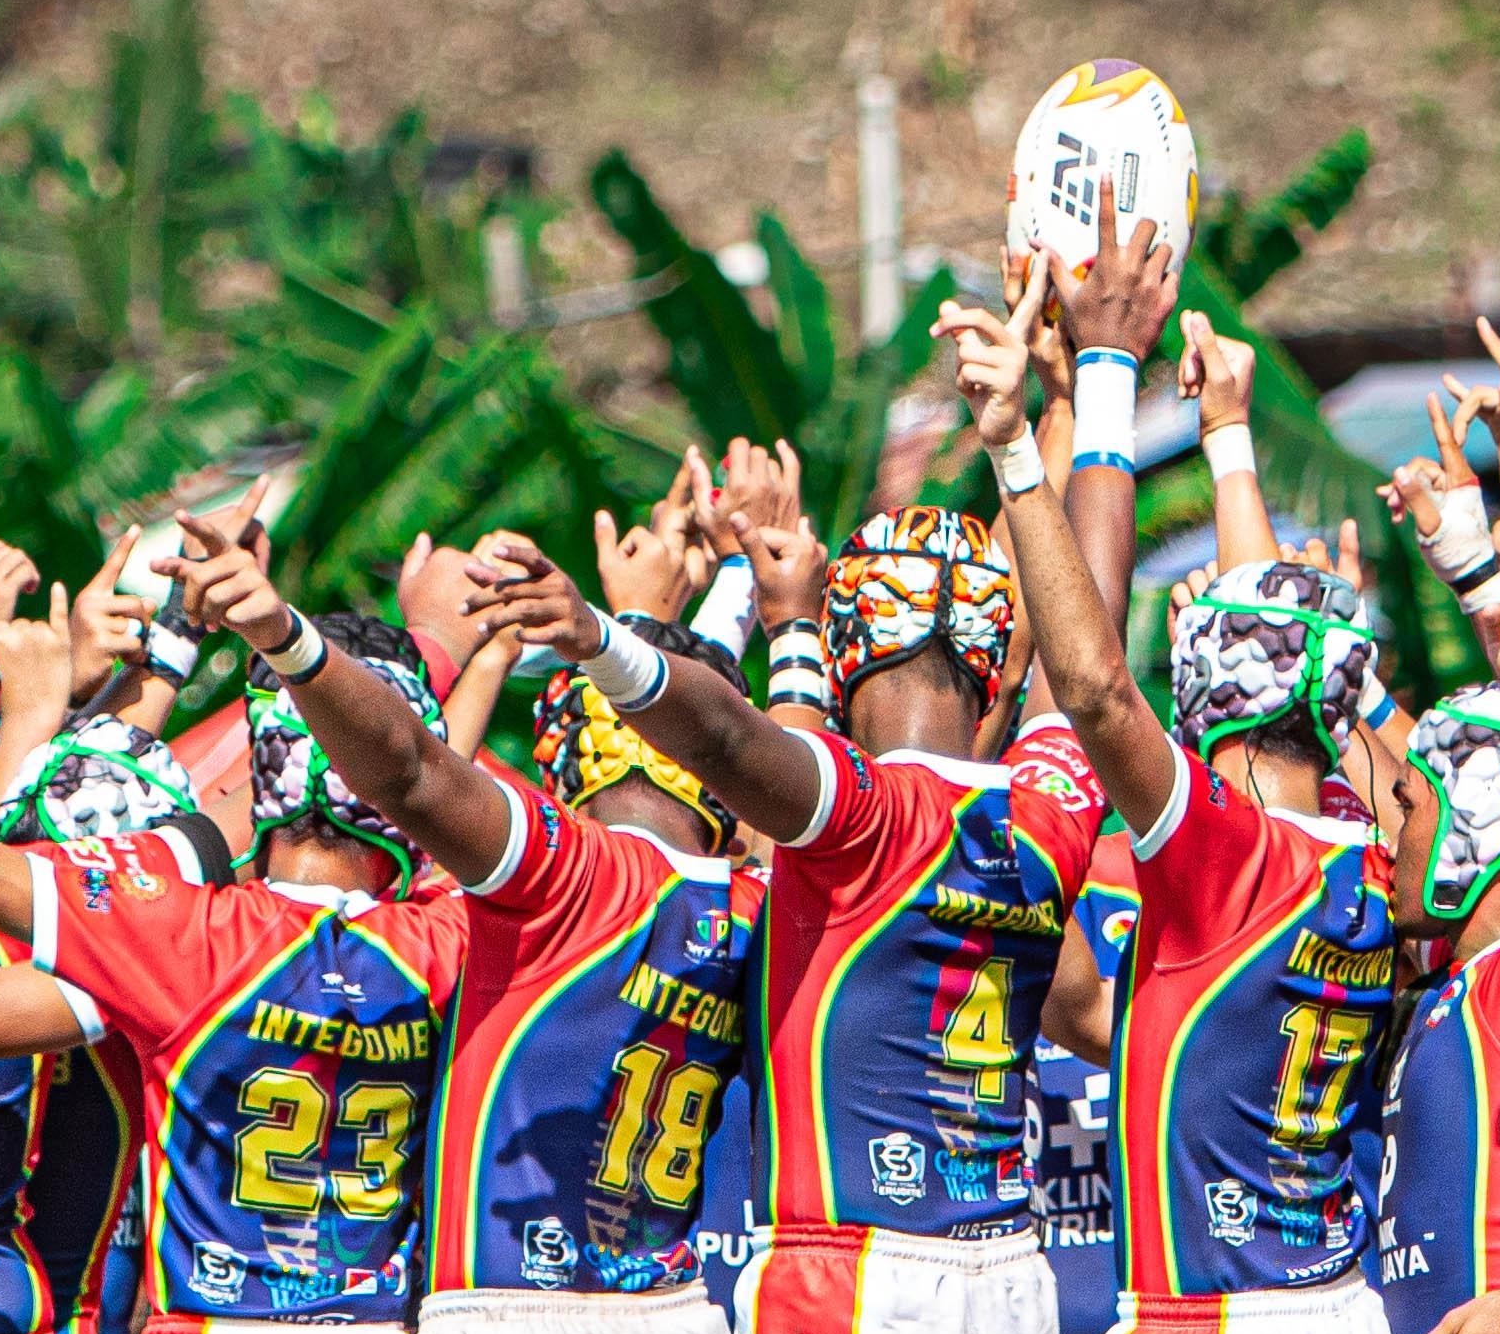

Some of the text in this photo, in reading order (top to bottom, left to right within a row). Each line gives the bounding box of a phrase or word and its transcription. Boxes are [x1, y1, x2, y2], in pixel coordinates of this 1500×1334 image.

[247, 998, 429, 1063] INTEGOMB
[943, 957, 1015, 1105] 4
[231, 1066, 416, 1223] 23
[595, 1038, 723, 1213] 18
